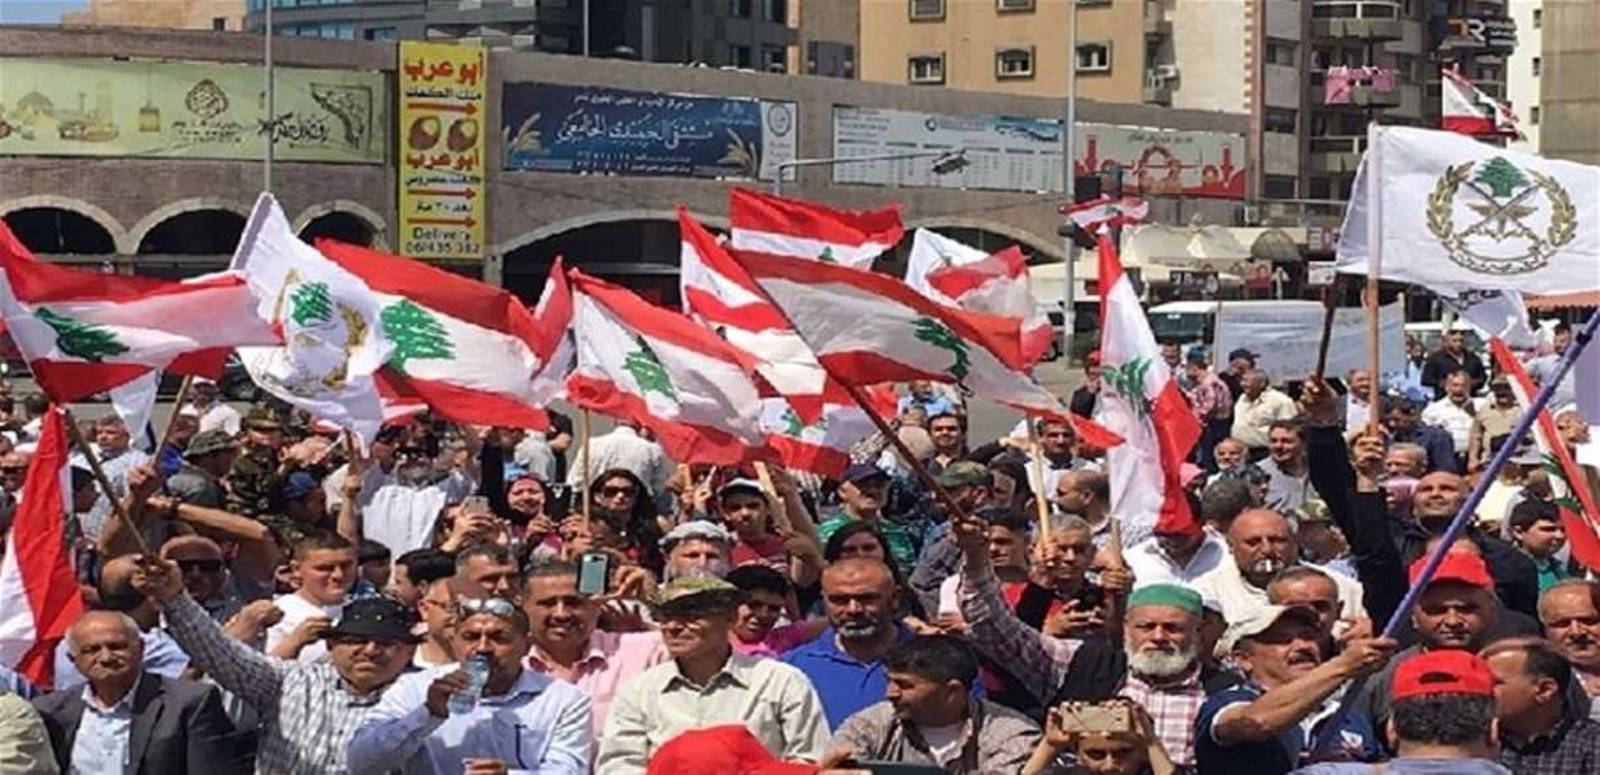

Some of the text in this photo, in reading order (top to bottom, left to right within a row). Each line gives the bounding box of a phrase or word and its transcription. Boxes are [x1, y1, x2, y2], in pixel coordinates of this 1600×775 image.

[404, 59, 454, 82] عرب
[405, 153, 452, 171] عرب
[412, 227, 472, 242] Delivery
